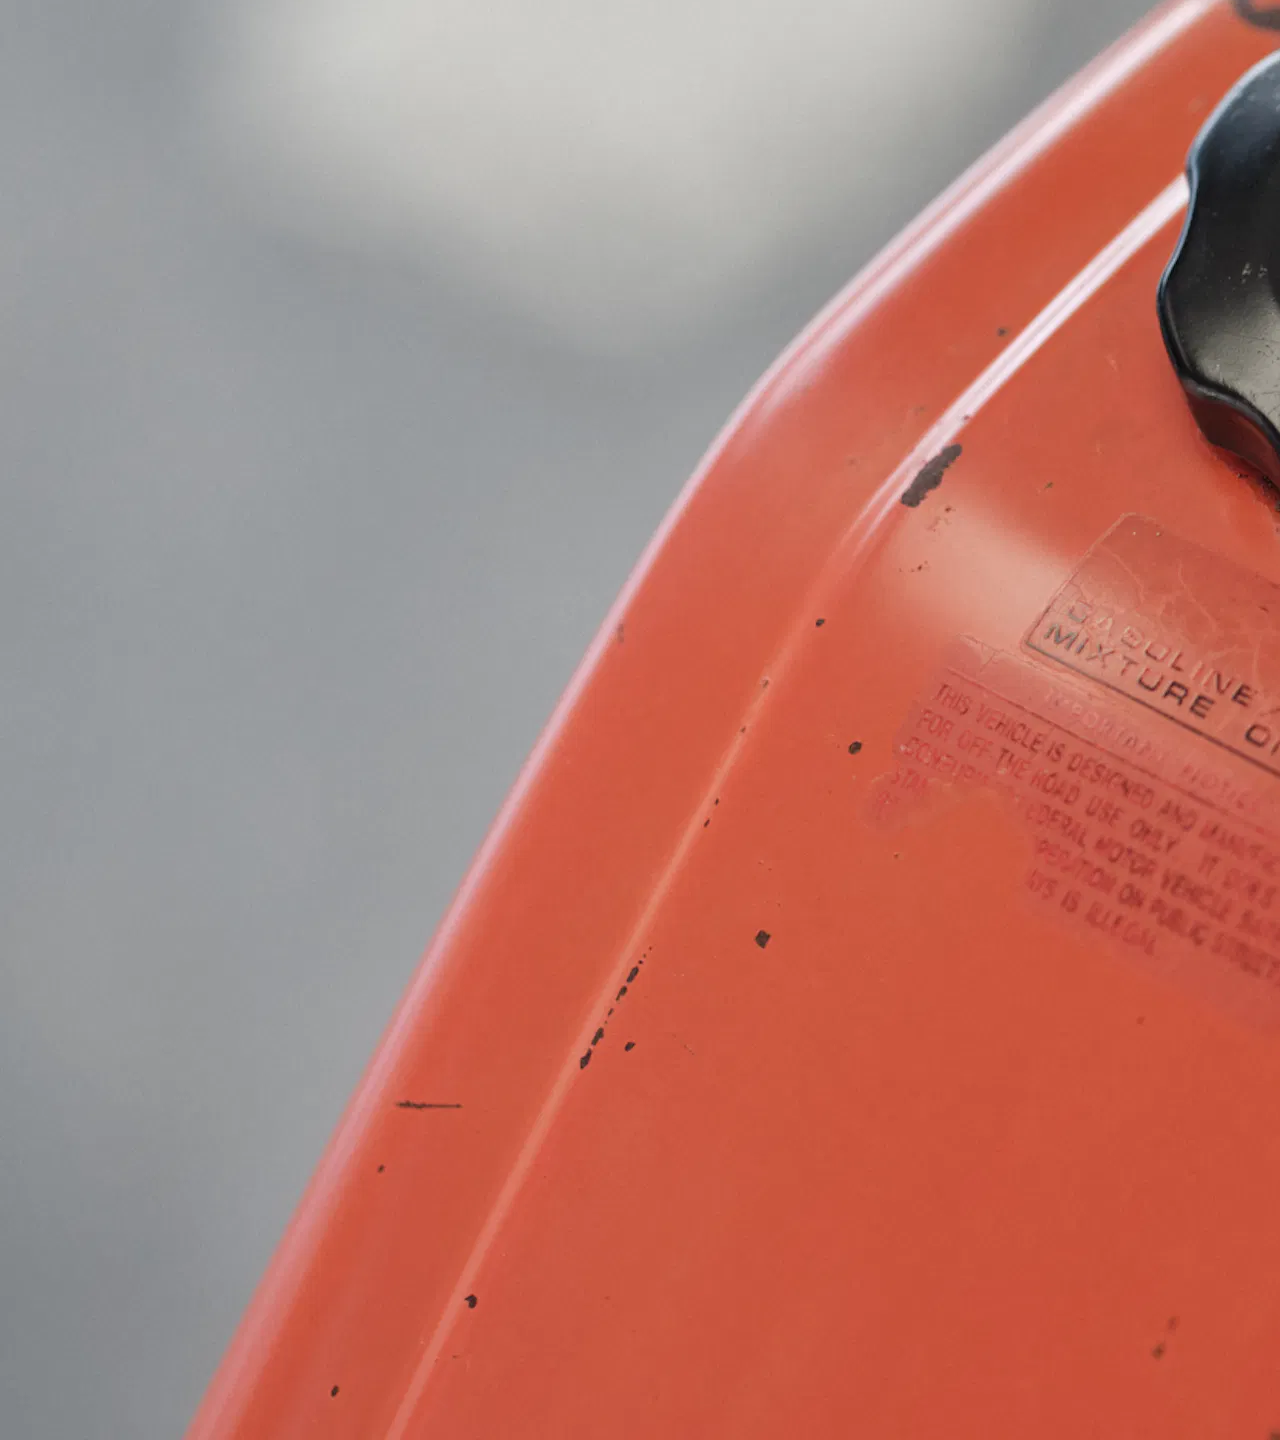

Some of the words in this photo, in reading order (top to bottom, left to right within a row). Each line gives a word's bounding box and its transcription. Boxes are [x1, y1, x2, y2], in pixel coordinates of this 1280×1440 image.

[1043, 619, 1214, 720] MIXTURE
[916, 708, 953, 741] FOR
[1086, 795, 1122, 827] USE
[932, 682, 973, 716] THIS
[975, 704, 1045, 752] VEHICLE
[1046, 740, 1065, 762] IS
[1067, 751, 1156, 809] DESIGNED
[1159, 799, 1197, 831] AND
[1118, 881, 1147, 909] ON
